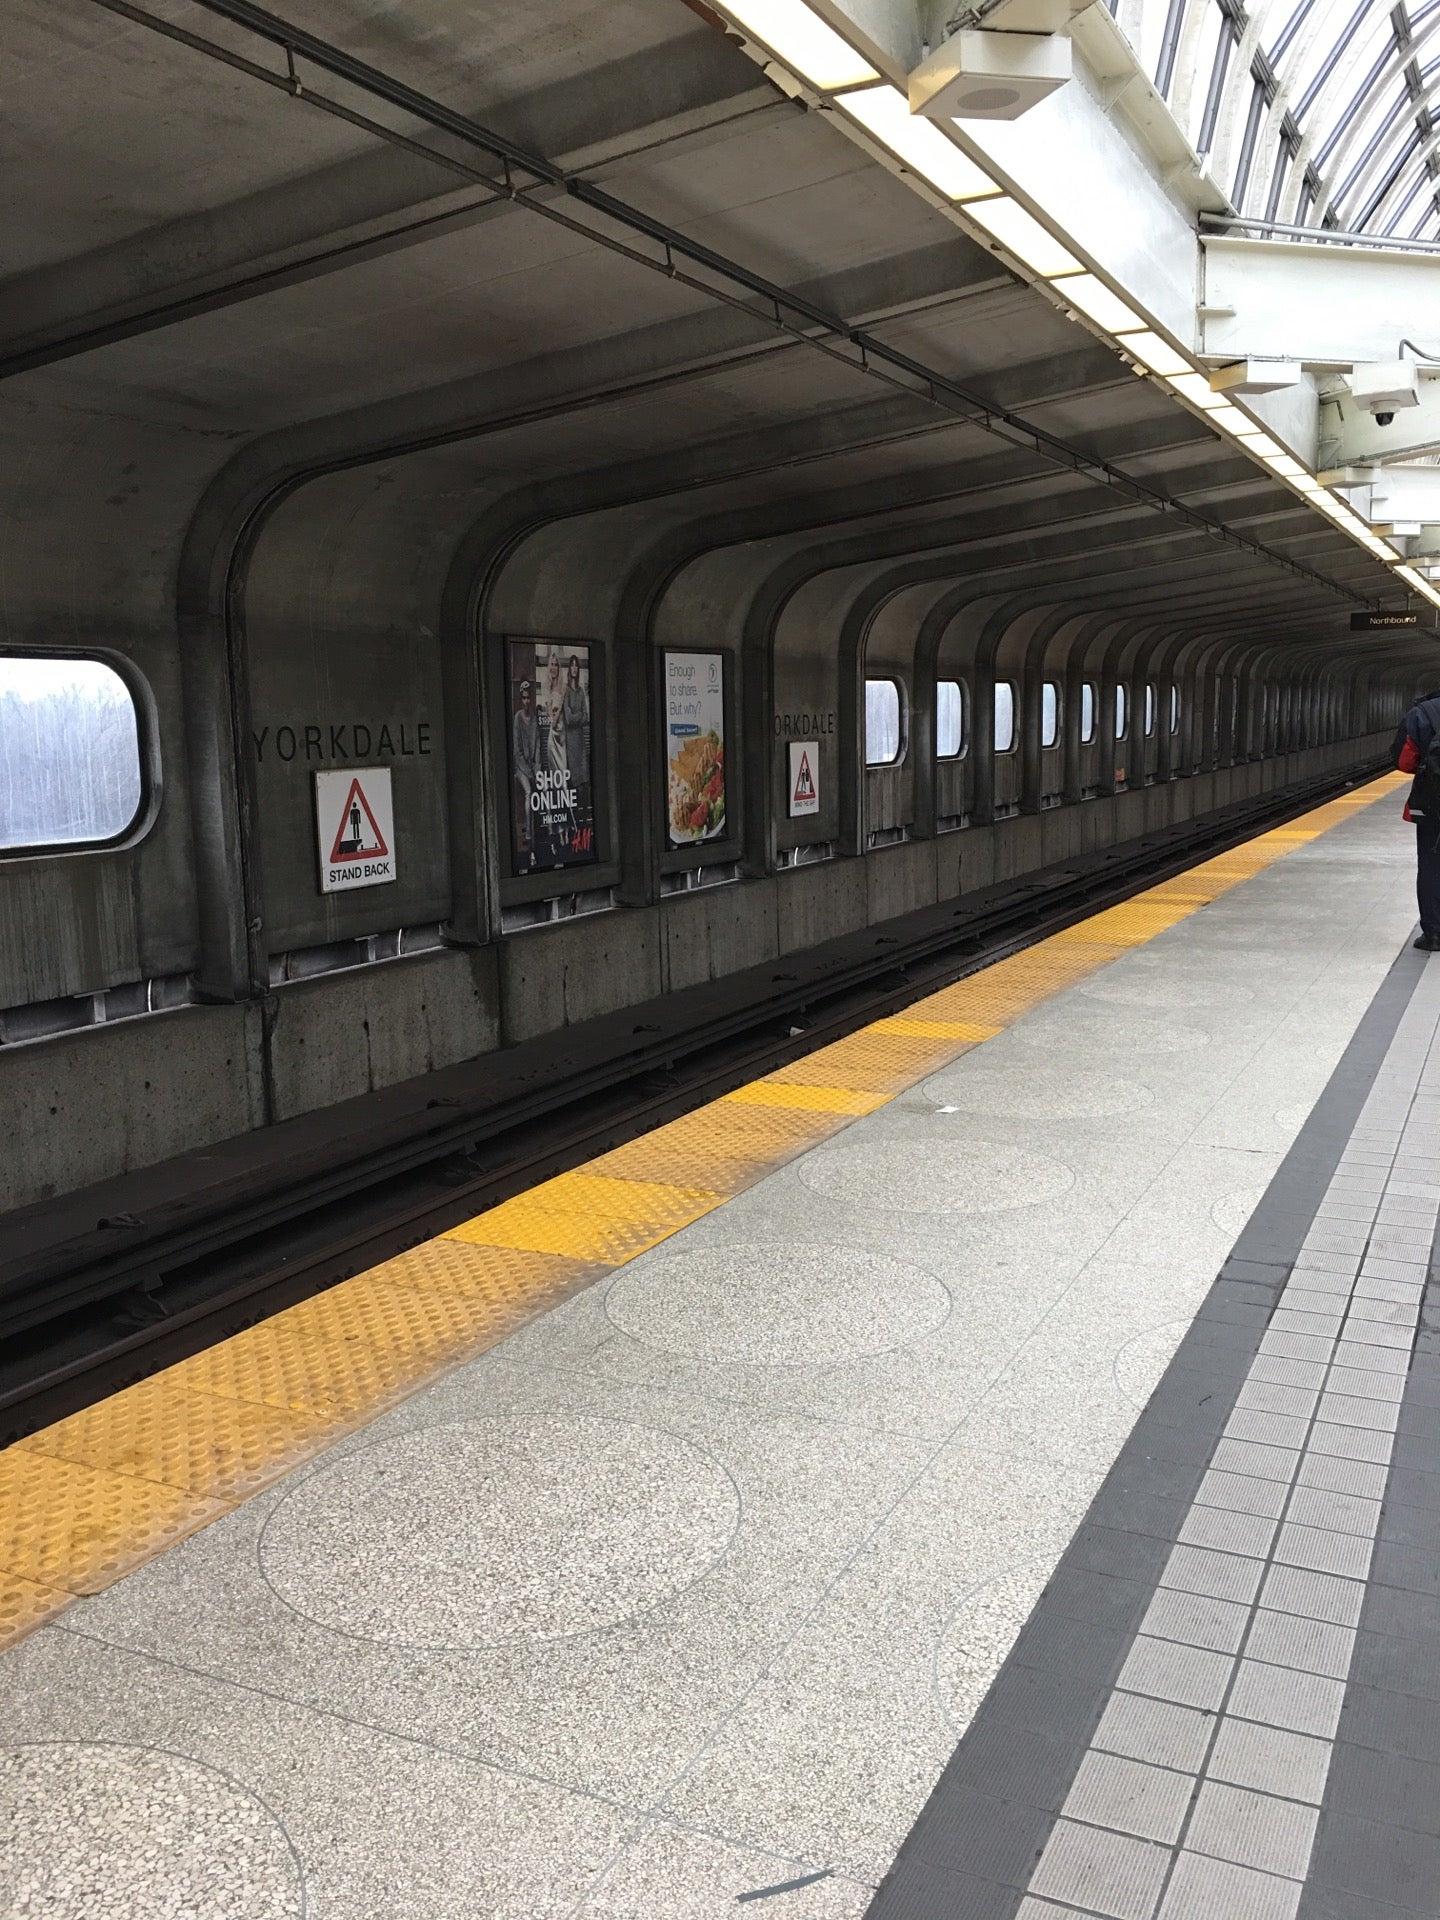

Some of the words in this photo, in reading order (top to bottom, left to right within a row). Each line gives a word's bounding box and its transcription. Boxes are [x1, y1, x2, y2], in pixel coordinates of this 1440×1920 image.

[1369, 615, 1417, 625] Northbound
[669, 662, 696, 680] Enough
[678, 682, 698, 697] share
[669, 701, 683, 716] But
[683, 700, 702, 718] why?
[774, 713, 834, 737] ORKDALE
[251, 723, 432, 763] YORKDALE
[535, 769, 571, 791] SHOP
[530, 788, 578, 812] ONLINE
[329, 866, 363, 883] STAND
[364, 861, 391, 877] BACK
